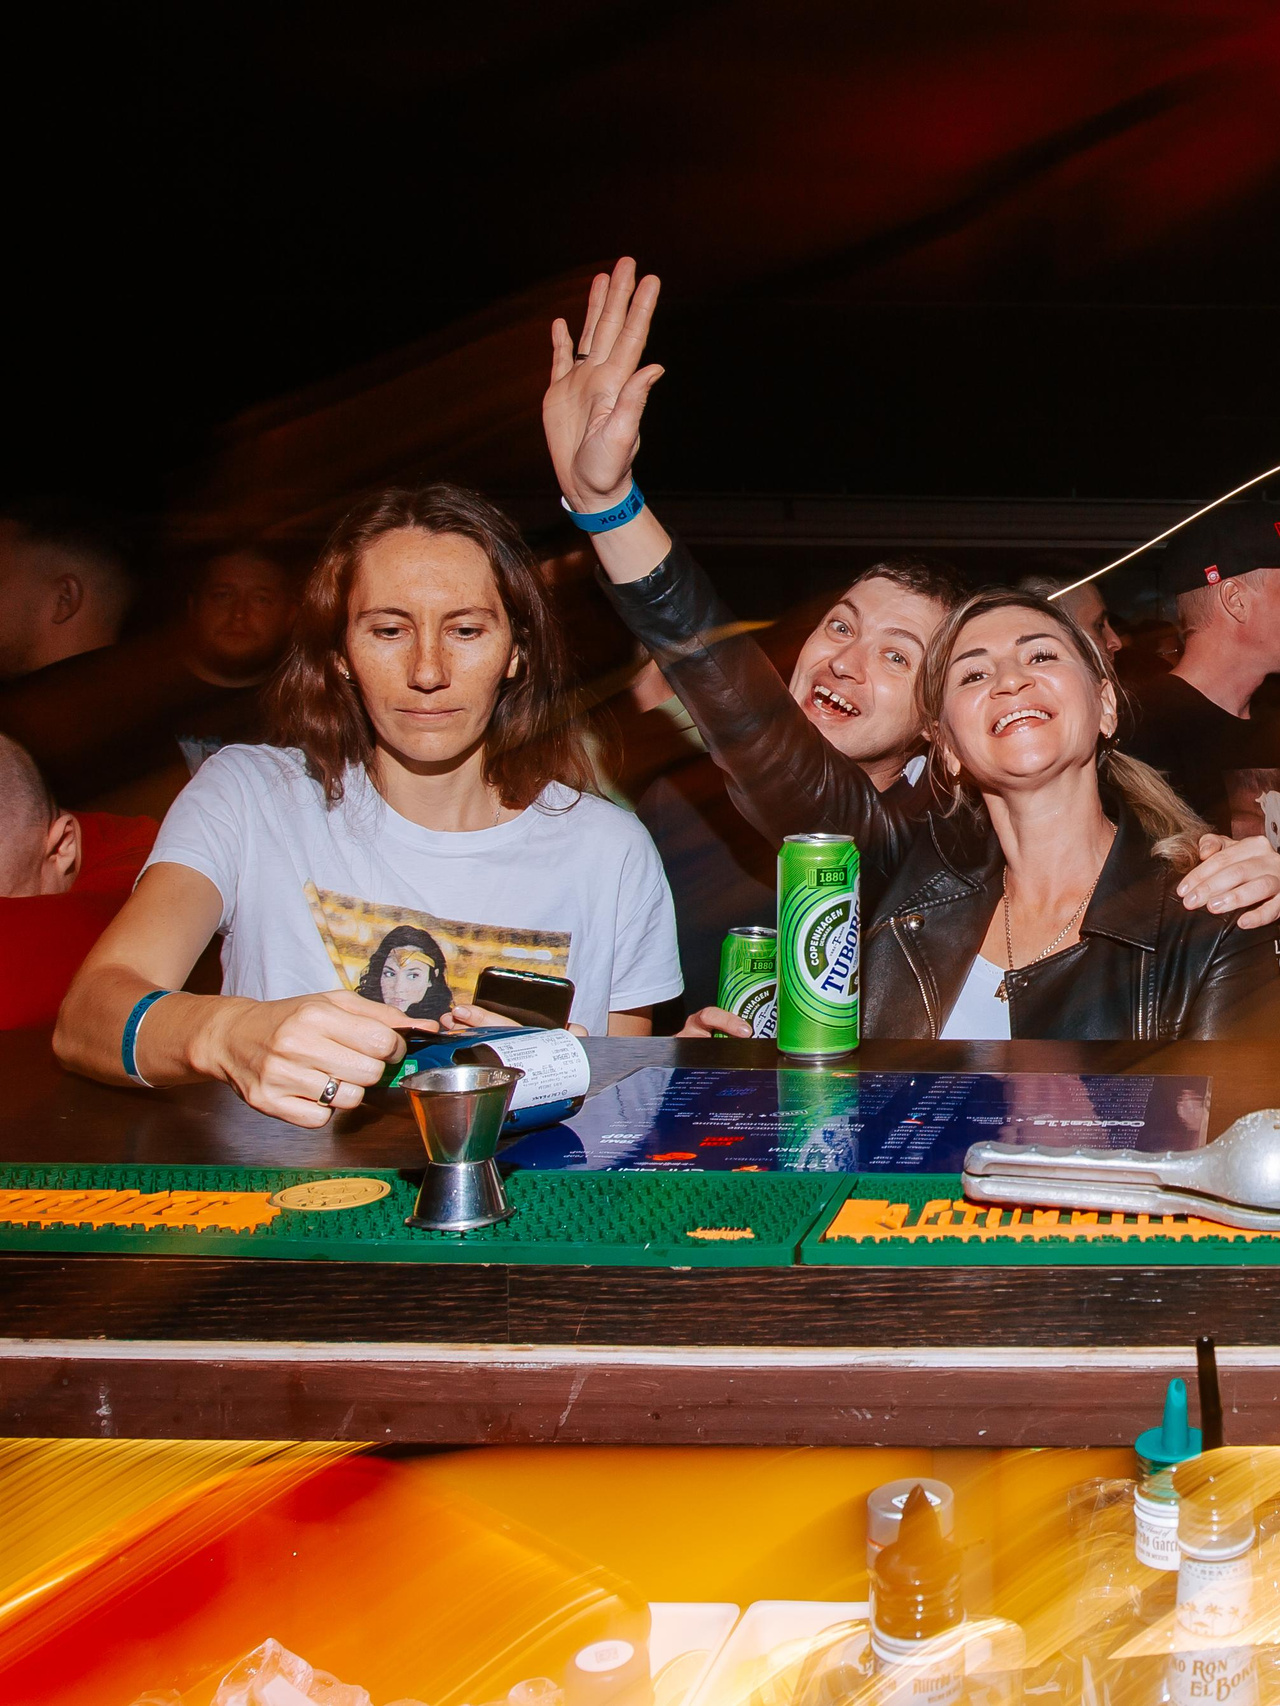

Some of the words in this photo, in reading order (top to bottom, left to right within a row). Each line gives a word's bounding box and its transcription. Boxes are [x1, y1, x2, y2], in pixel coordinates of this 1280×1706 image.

[819, 871, 845, 883] 1880
[809, 908, 843, 966] COPENHAGEN
[752, 962, 774, 970] 1880
[741, 990, 770, 1020] ENHAGEN
[1033, 1119, 1145, 1128] Cocktails
[1152, 1536, 1180, 1552] Garci
[1192, 1659, 1227, 1684] RON
